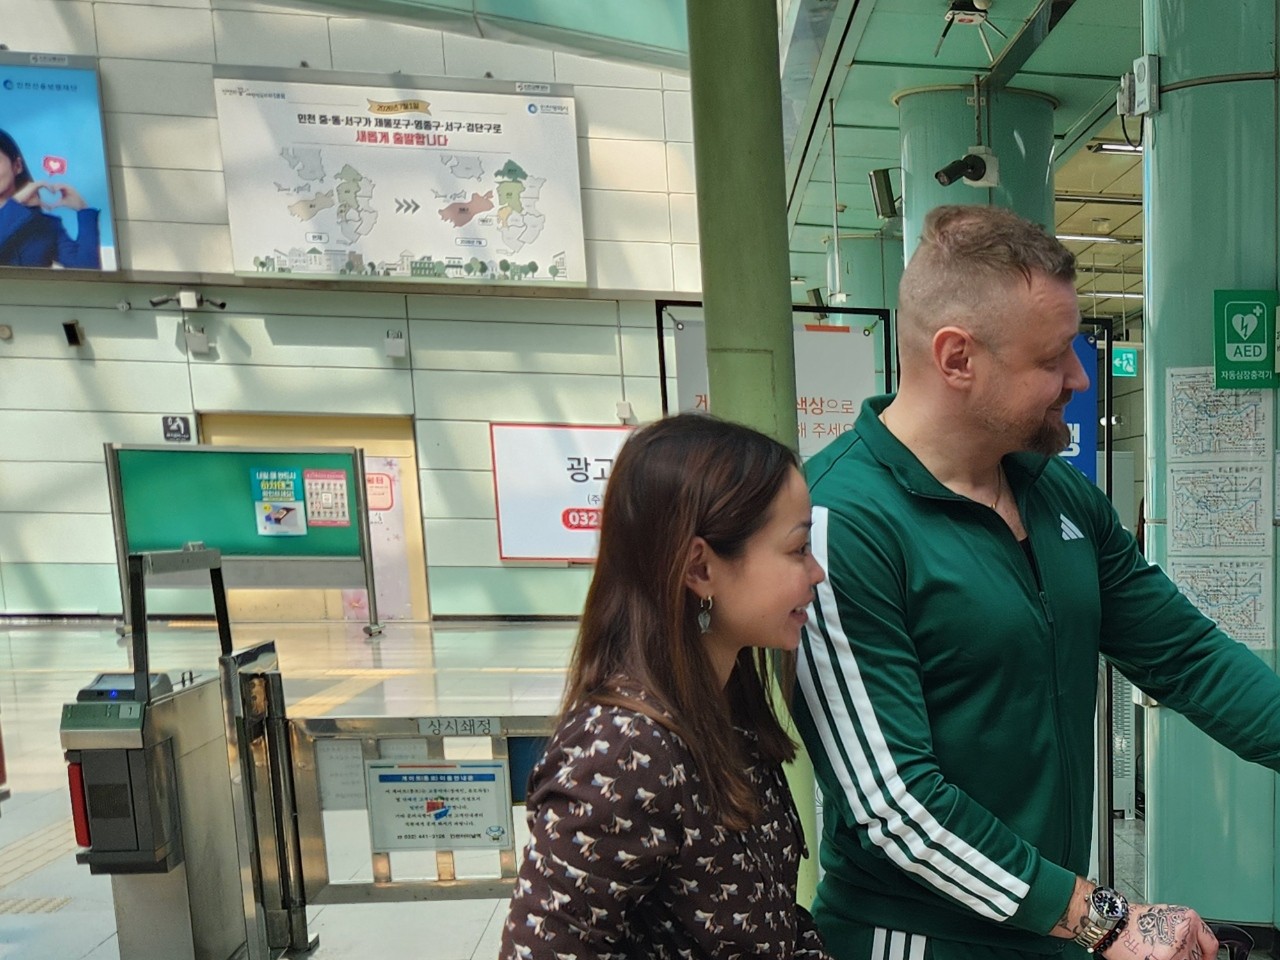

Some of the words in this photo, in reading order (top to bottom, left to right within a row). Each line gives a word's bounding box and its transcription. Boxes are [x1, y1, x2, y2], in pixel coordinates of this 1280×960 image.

[297, 114, 316, 125] 인천
[355, 130, 390, 145] 새롭게
[393, 131, 448, 147] 출발합니다
[1233, 345, 1263, 358] AED
